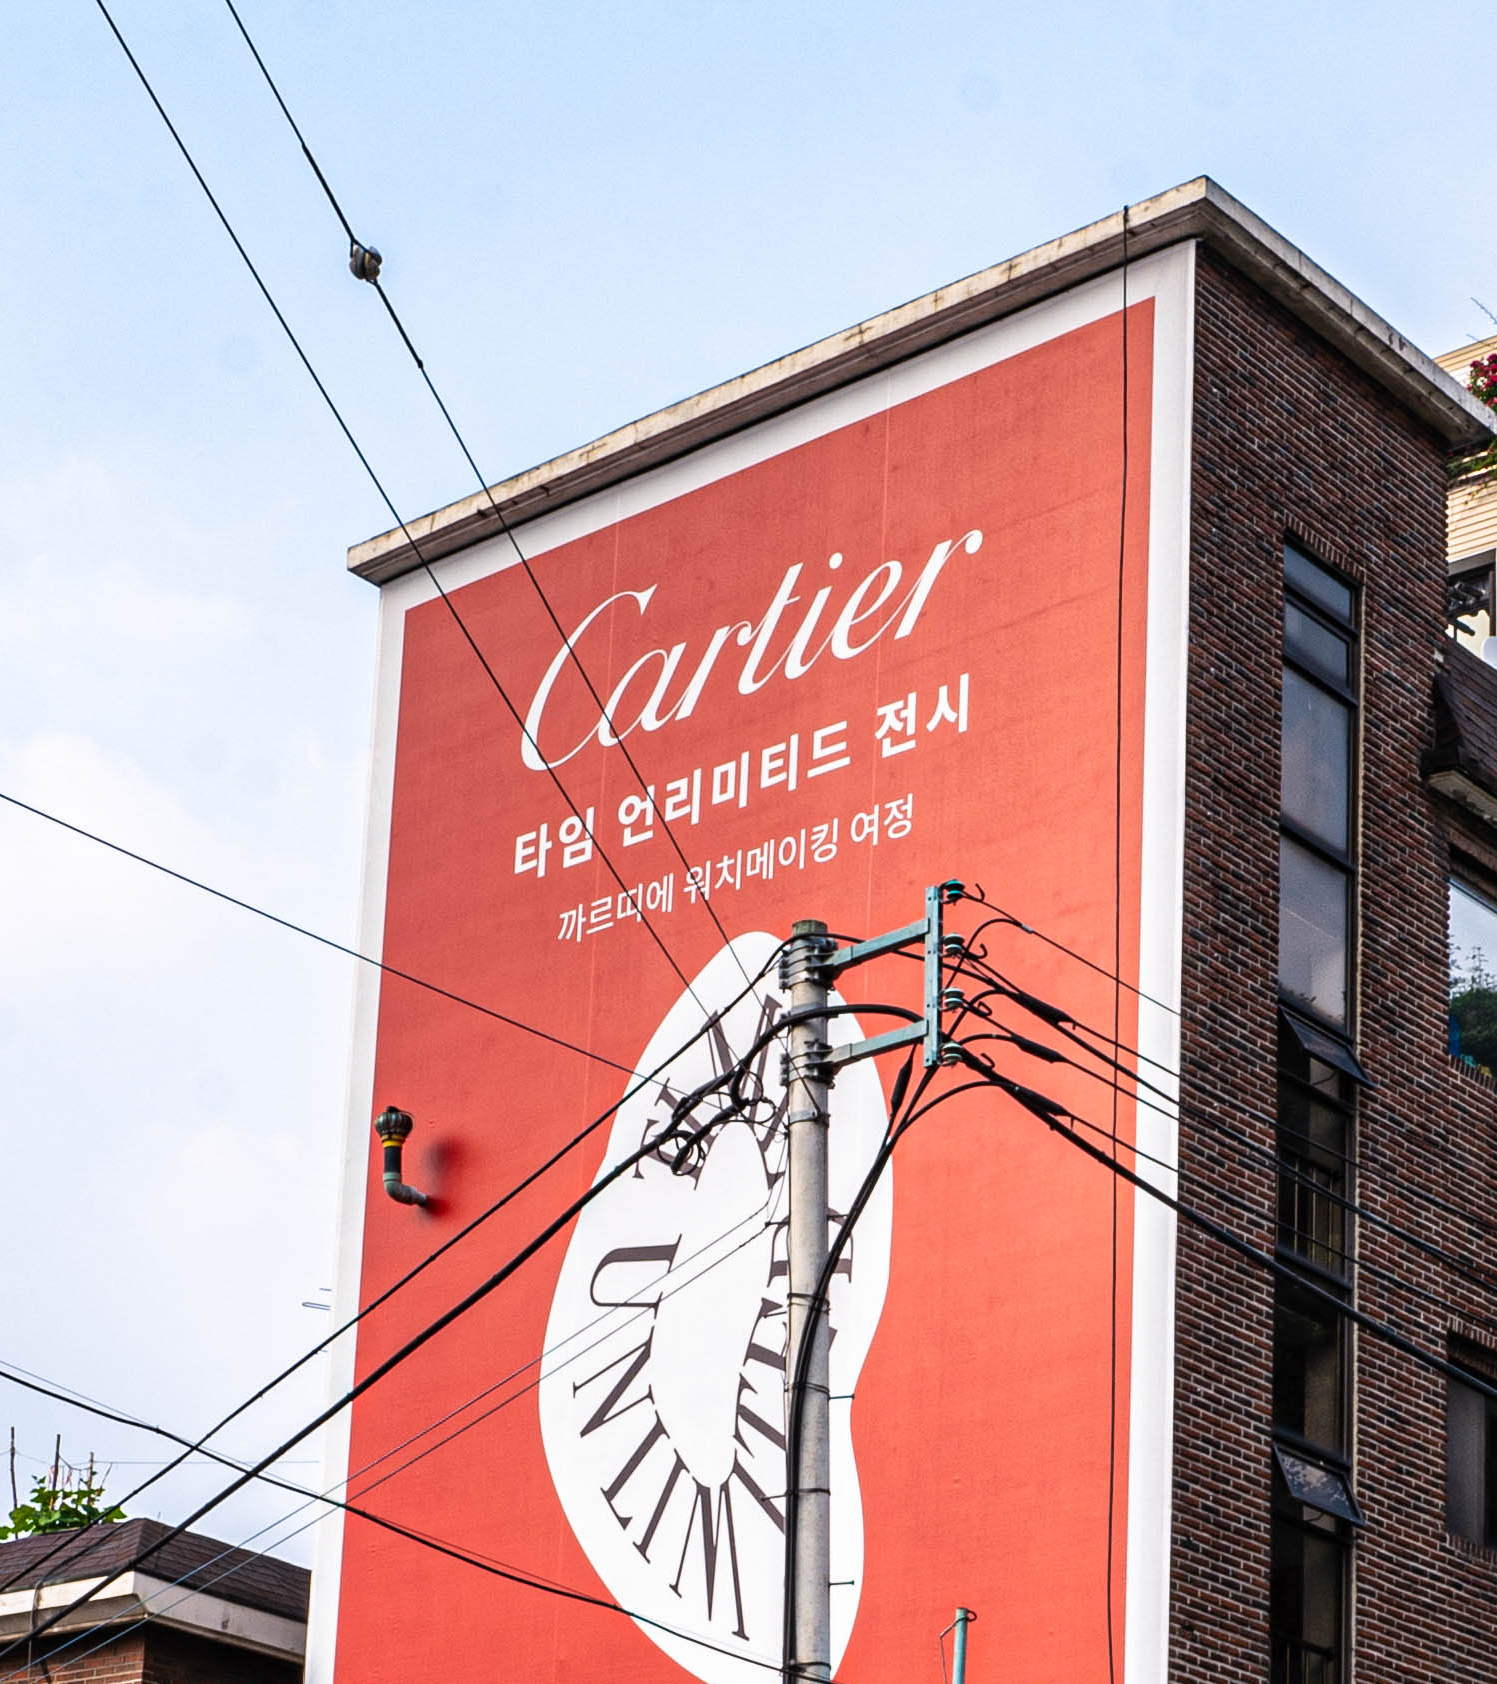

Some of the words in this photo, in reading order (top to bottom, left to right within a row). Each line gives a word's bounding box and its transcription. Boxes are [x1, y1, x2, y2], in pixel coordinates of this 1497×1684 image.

[520, 528, 983, 772] Cartier
[514, 807, 595, 878] 타임
[617, 721, 851, 847] 언리미티드
[875, 673, 970, 759] 전시
[557, 872, 674, 943] 까르띠에
[683, 818, 839, 903] 워치메이킹
[849, 793, 914, 847] 여정
